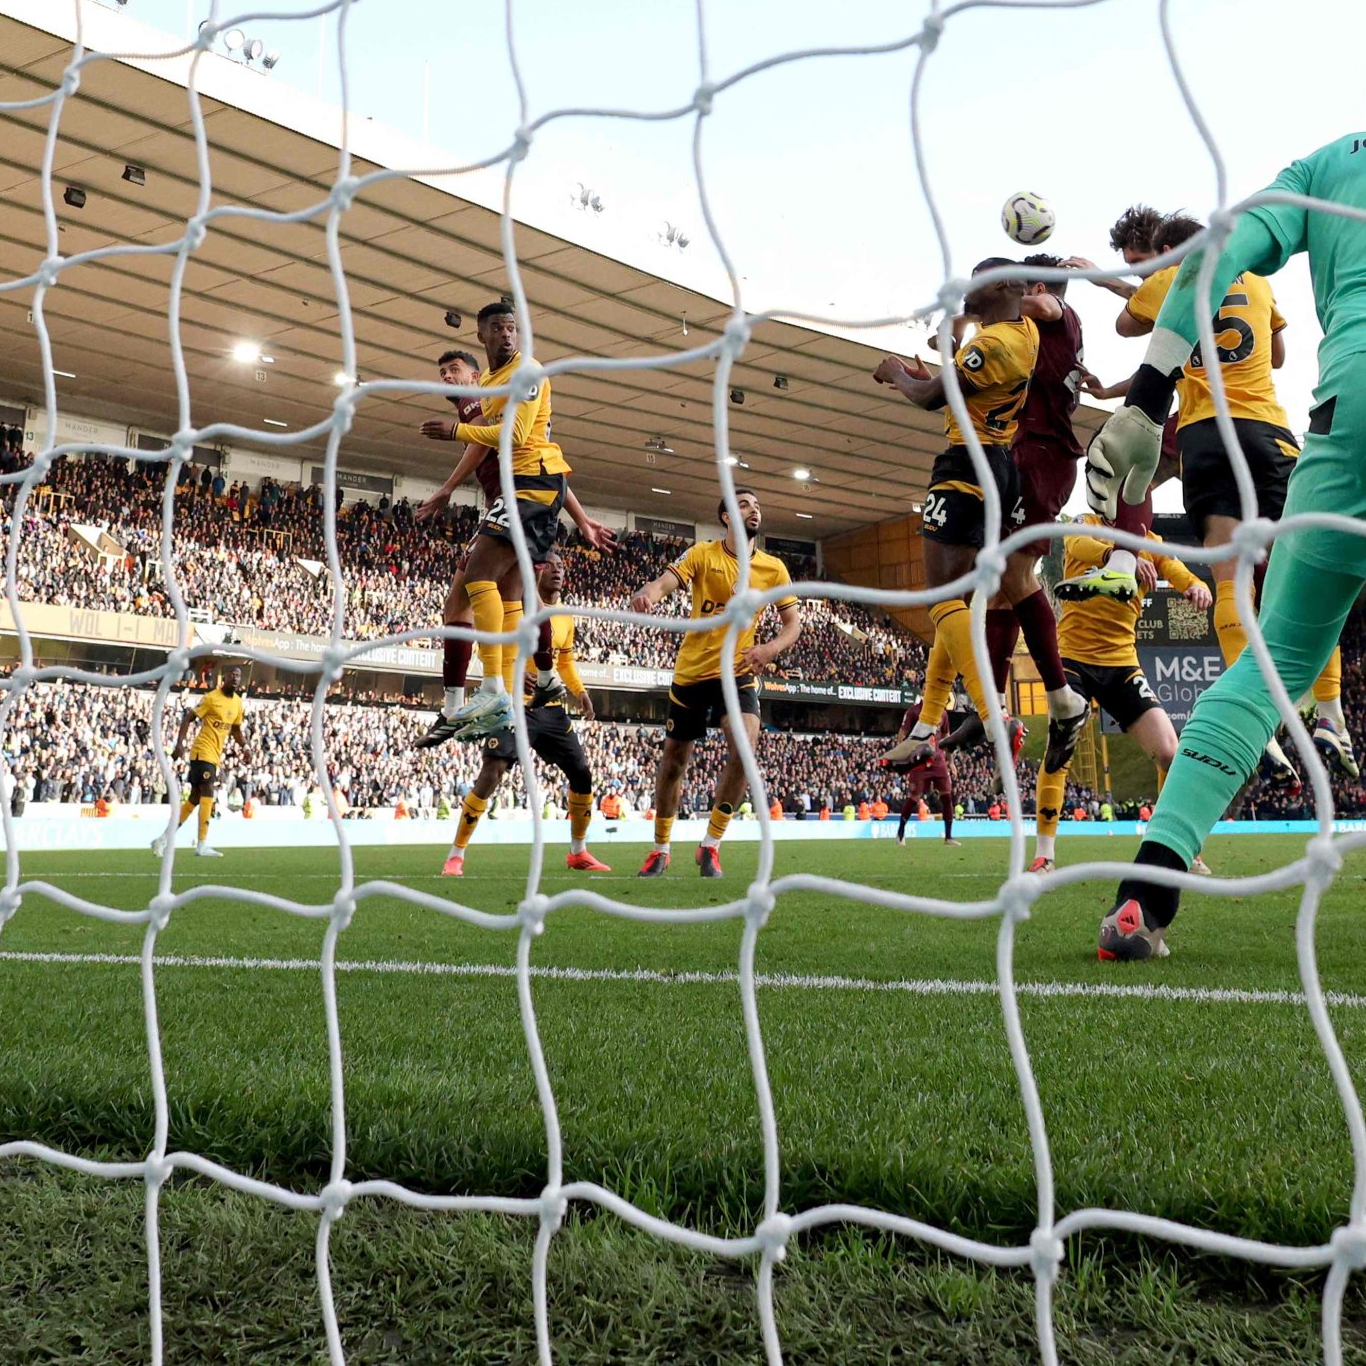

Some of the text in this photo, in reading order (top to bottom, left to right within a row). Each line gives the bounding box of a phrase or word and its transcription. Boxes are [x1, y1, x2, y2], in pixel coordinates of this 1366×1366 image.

[64, 421, 99, 435] MANDER
[336, 473, 367, 484] MANDER
[923, 493, 948, 527] 24
[69, 610, 103, 637] WOL
[1138, 619, 1164, 629] CLUB
[296, 639, 310, 652] The
[397, 647, 437, 669] CONTENT
[613, 667, 657, 685] EXCLUSIVE
[1155, 656, 1221, 682] M&E
[764, 680, 796, 694] WolvesApp
[800, 683, 811, 694] The
[811, 685, 826, 696] home
[838, 685, 873, 701] EXCLUSIVE
[873, 688, 902, 704] CONTENT
[1180, 748, 1237, 776] SUDU
